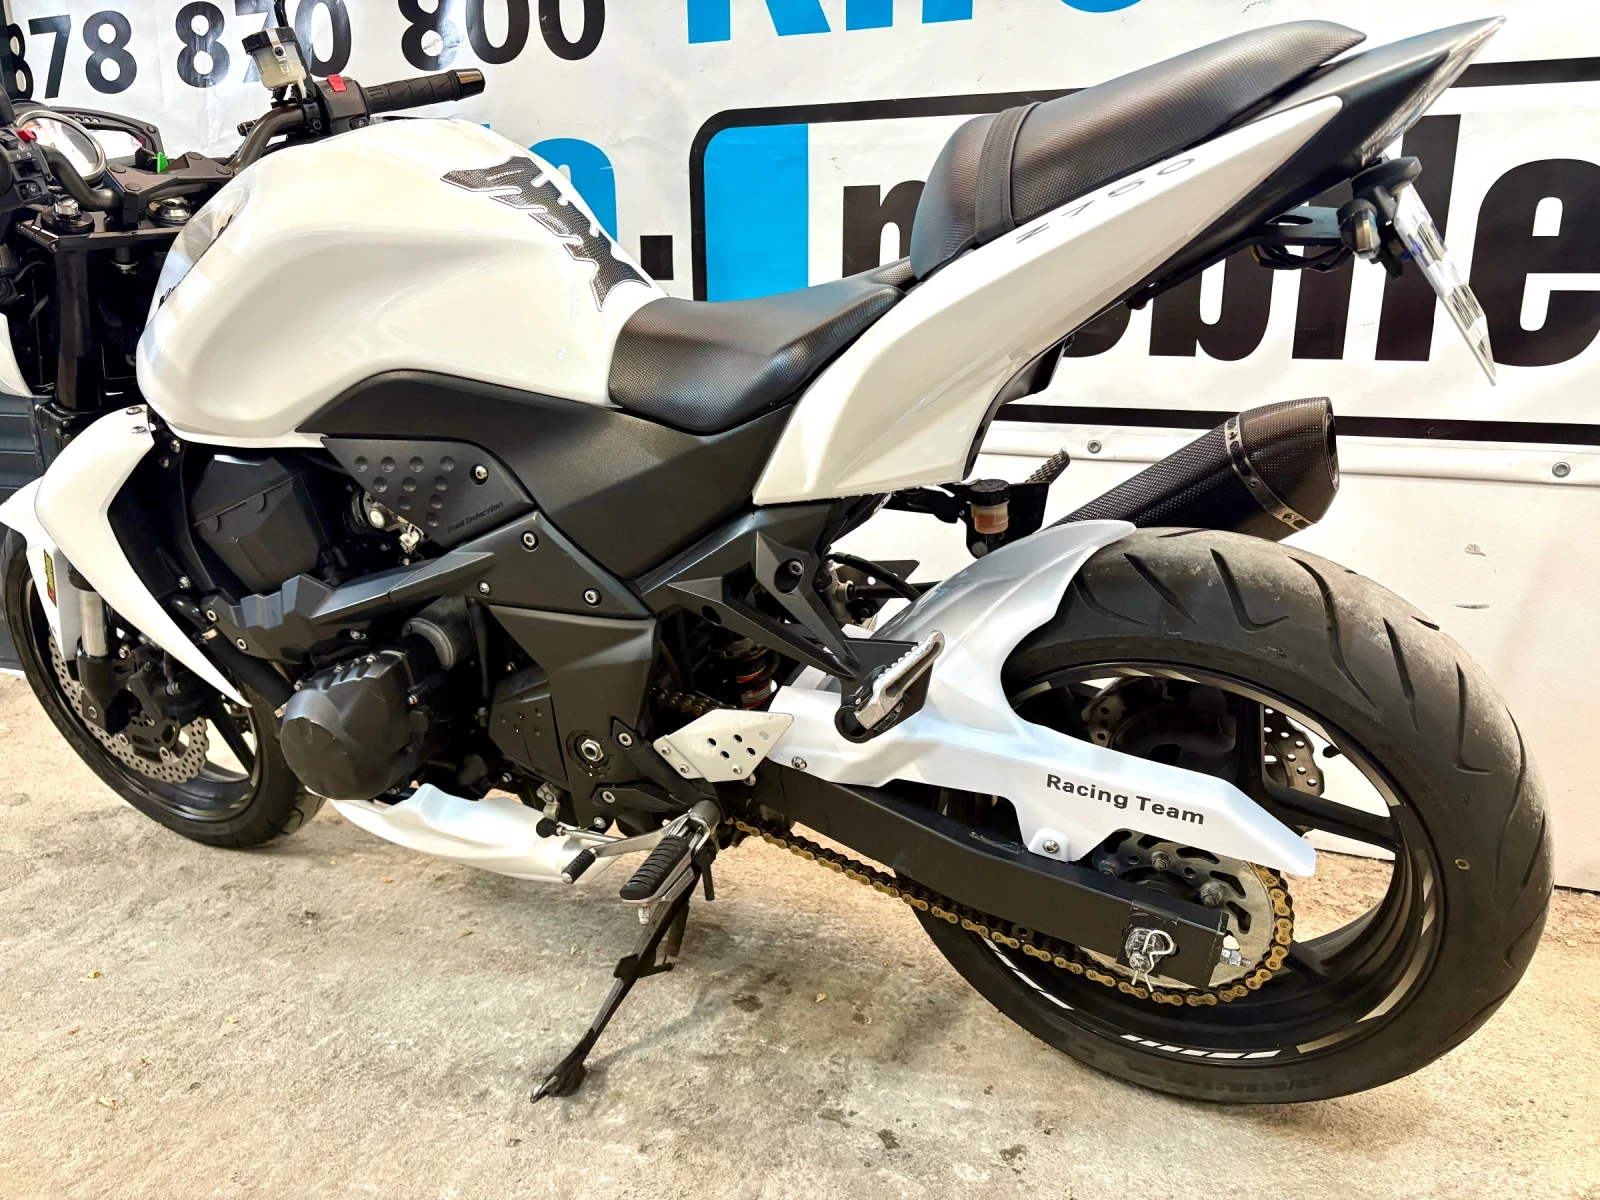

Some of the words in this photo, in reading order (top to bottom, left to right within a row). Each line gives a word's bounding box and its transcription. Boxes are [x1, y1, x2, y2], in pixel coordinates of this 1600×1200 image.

[175, 0, 351, 88] 870
[398, 0, 606, 71] 800
[1015, 158, 1196, 244] Z750
[447, 520, 465, 534] Fuel
[1046, 773, 1129, 810] Racing
[1136, 795, 1205, 825] Team
